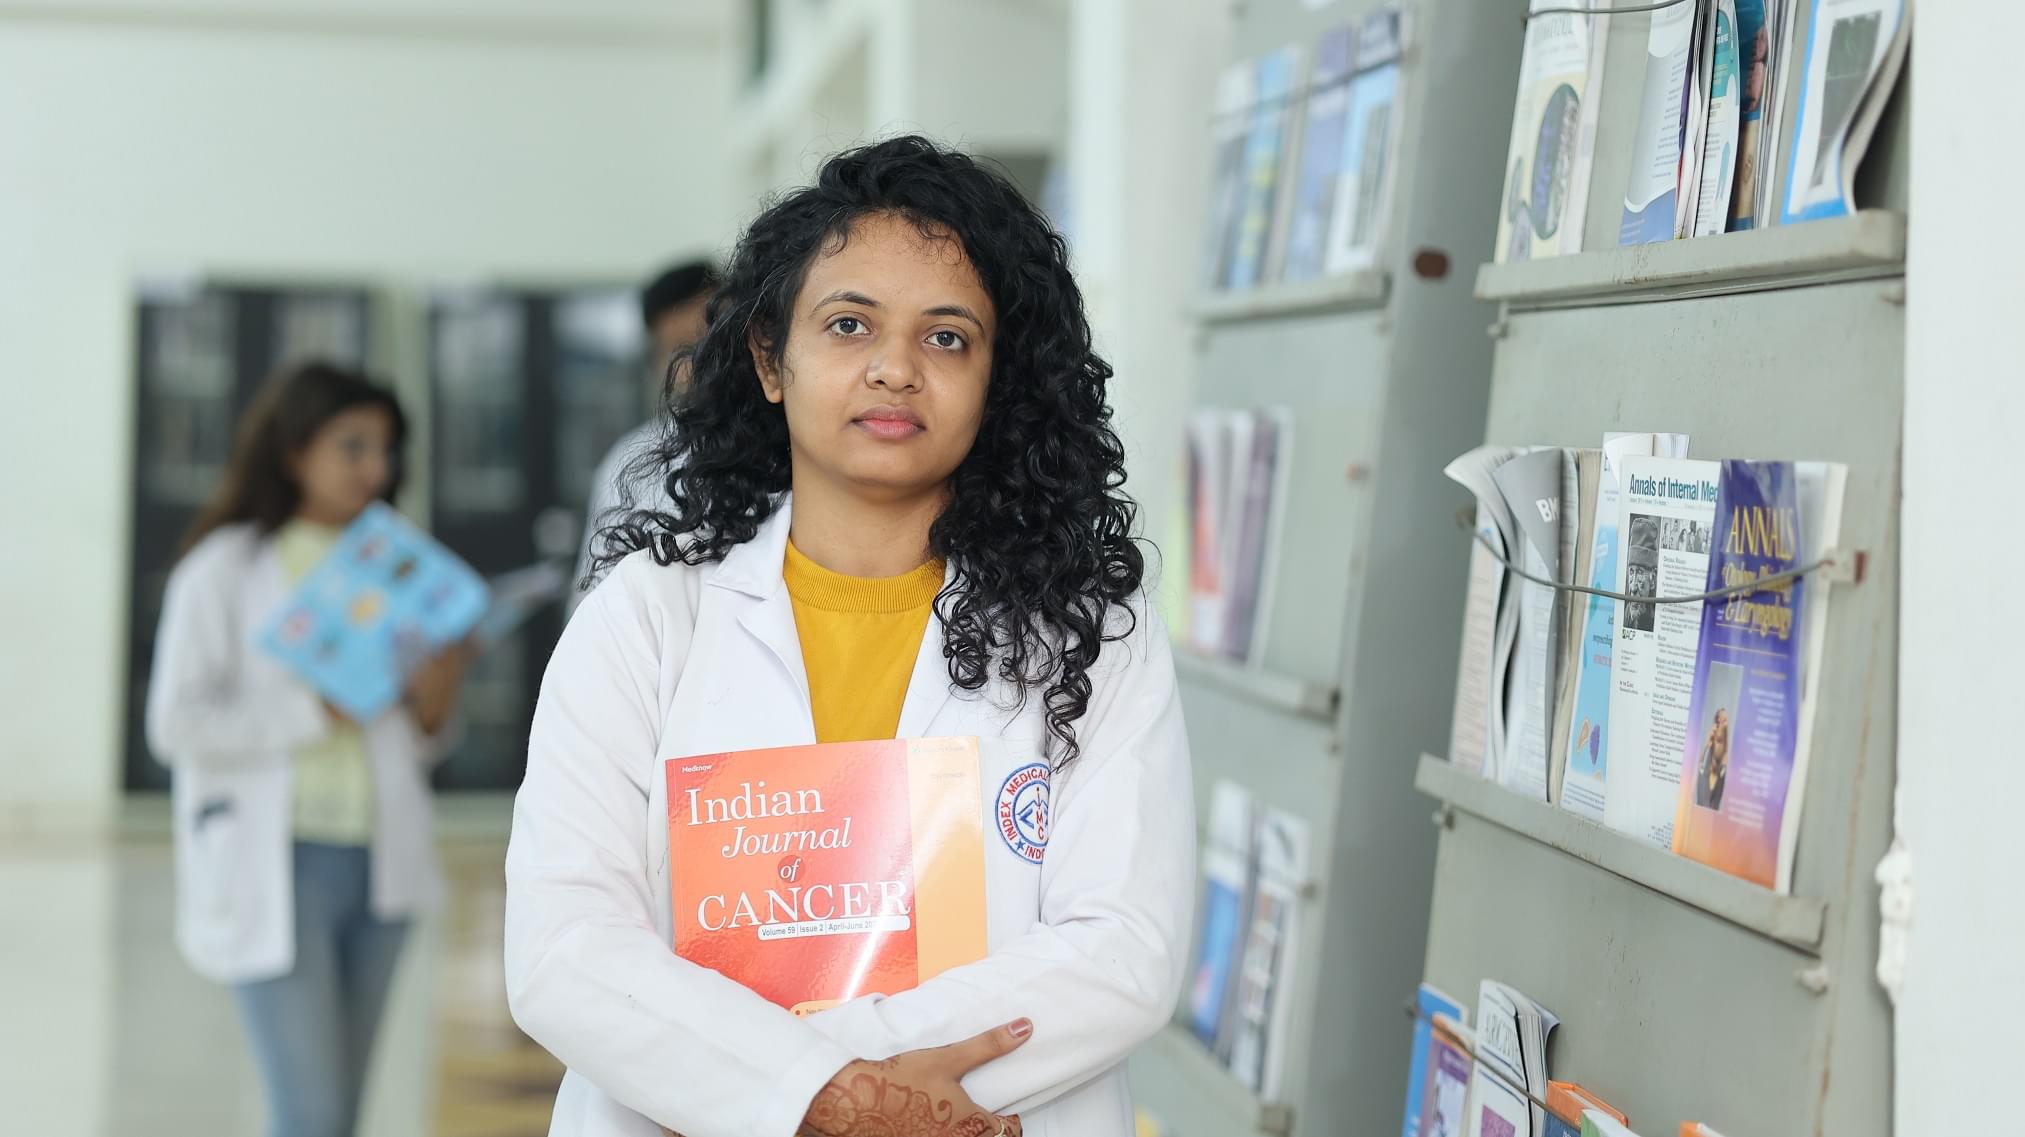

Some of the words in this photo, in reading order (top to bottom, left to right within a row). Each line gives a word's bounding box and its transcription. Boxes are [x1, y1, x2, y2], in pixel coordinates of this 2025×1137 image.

[1629, 473, 1656, 497] Annals
[1659, 476, 1667, 497] of
[1668, 477, 1699, 500] Internal
[1725, 505, 1795, 560] ANNALS
[1006, 768, 1048, 796] MEDICAL
[684, 780, 825, 826] Indian
[1000, 801, 1018, 841] INDEX
[721, 817, 852, 858] Journal
[780, 858, 801, 882] of
[697, 880, 911, 932] CANCER
[761, 927, 786, 937] Volume
[787, 926, 796, 934] 59
[799, 925, 818, 933] Issue
[819, 924, 824, 932] 2
[828, 920, 863, 931] April-June
